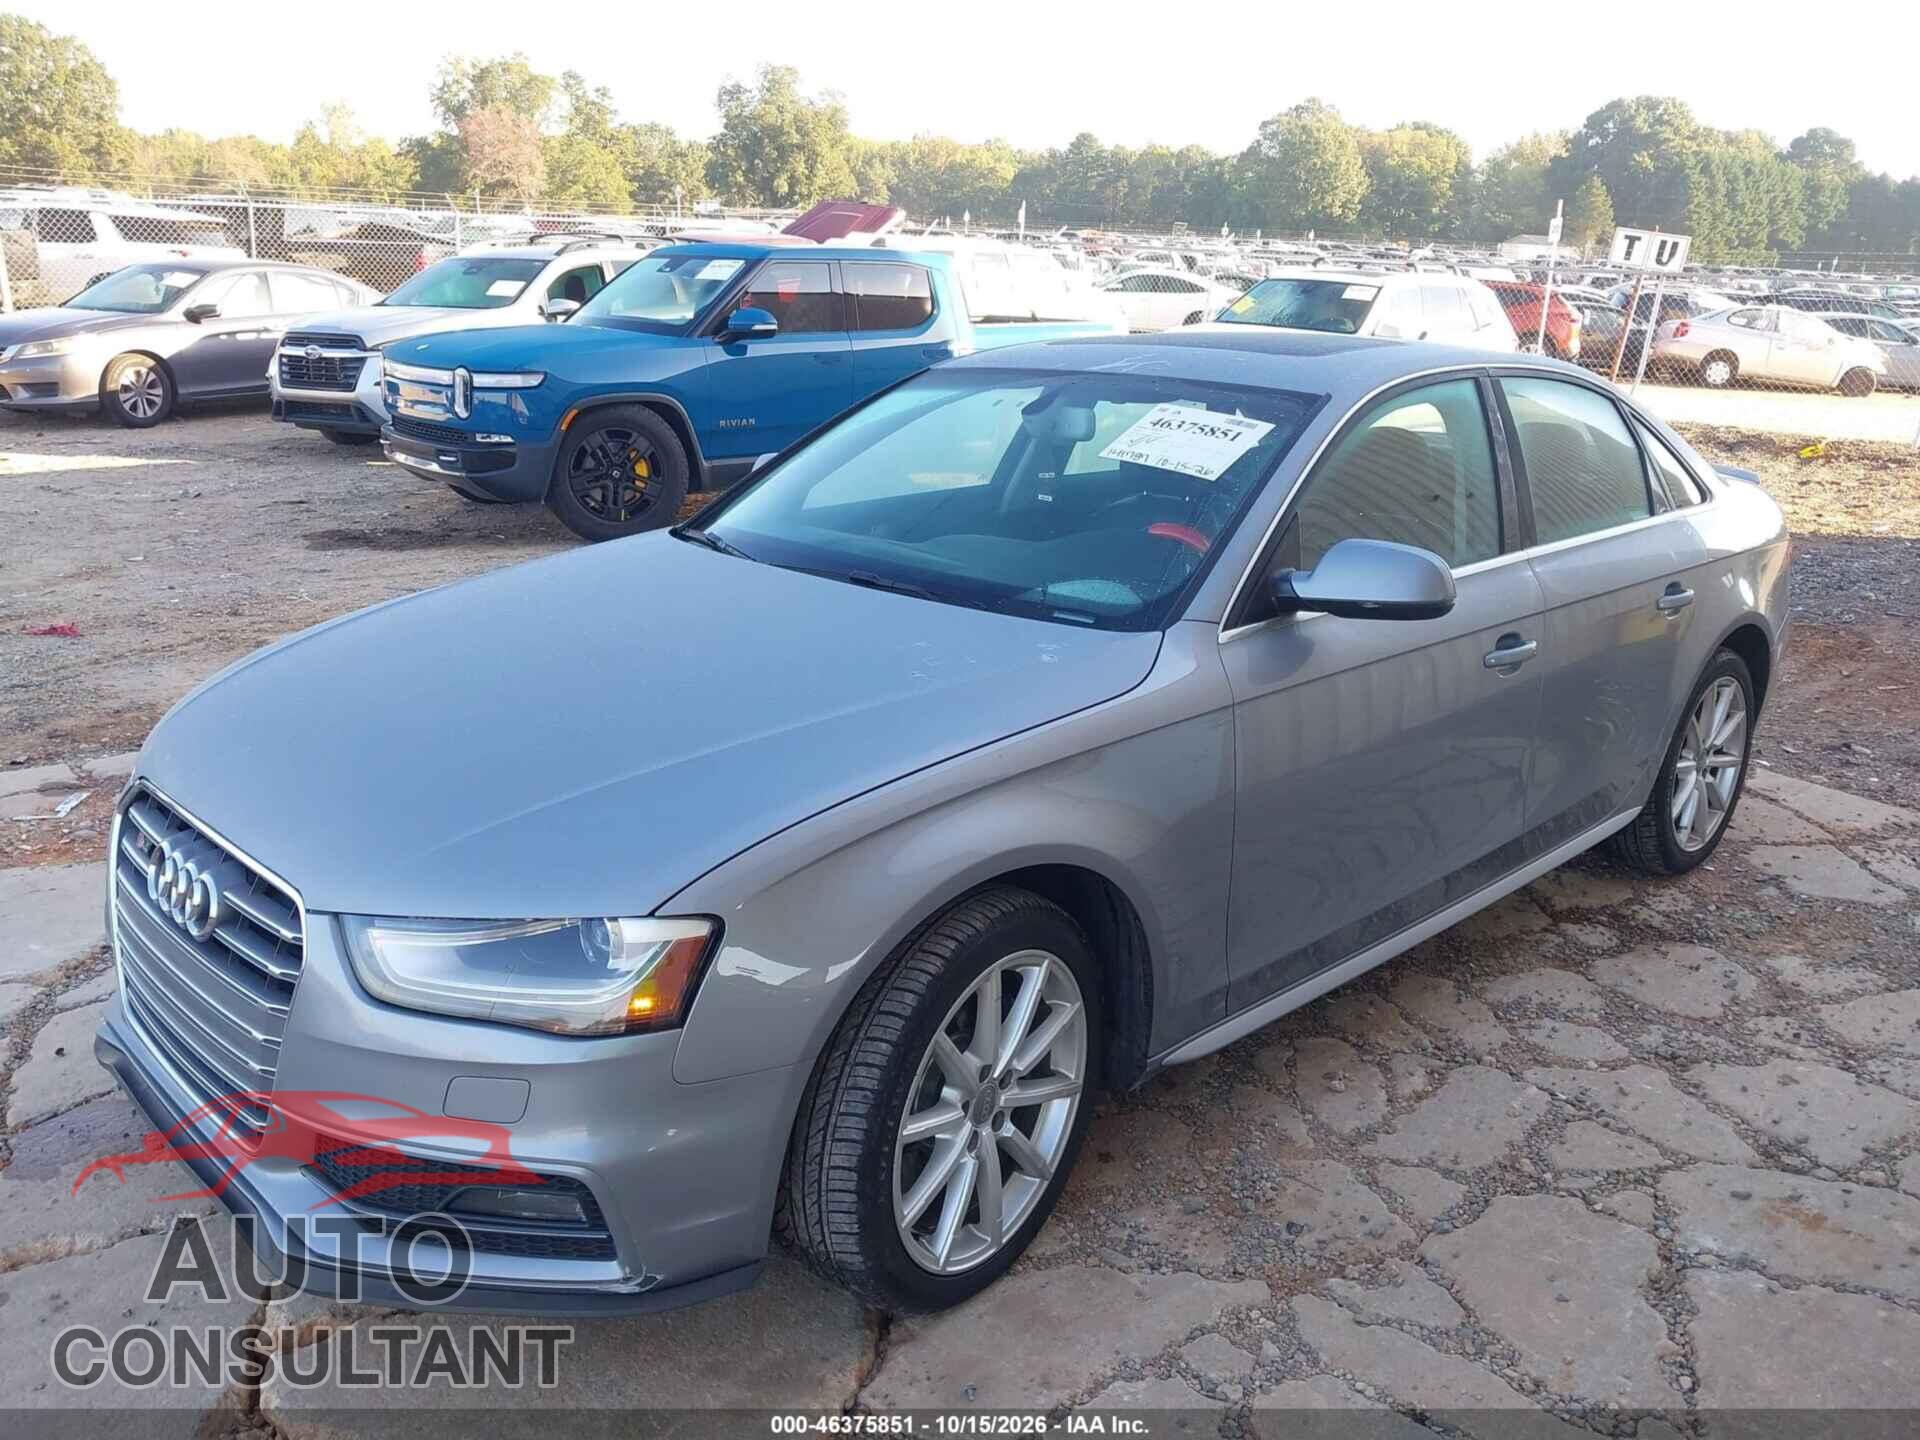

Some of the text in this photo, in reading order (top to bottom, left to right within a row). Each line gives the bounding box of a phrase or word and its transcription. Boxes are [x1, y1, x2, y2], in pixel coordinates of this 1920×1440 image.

[1623, 234, 1680, 267] T U
[719, 418, 756, 430] RIVIAN
[1150, 416, 1244, 443] 46375851
